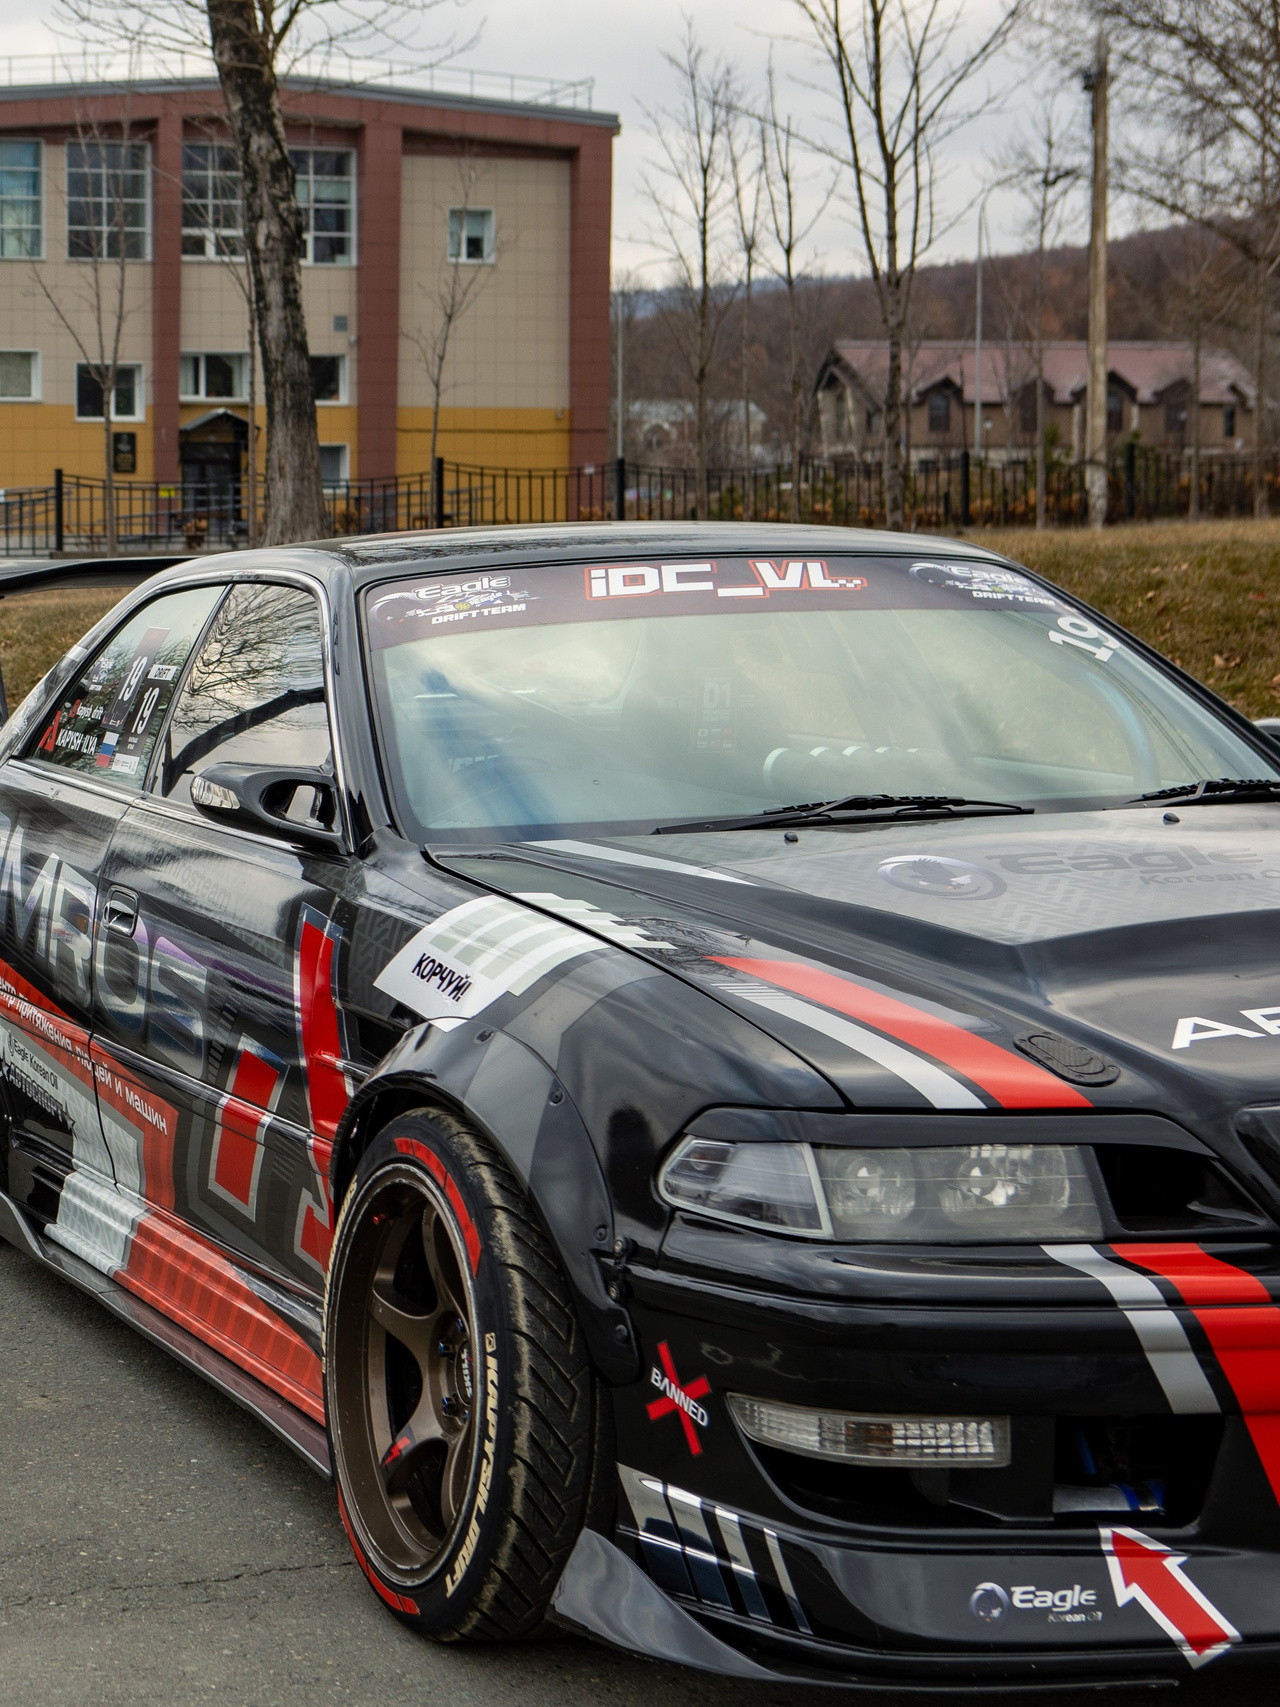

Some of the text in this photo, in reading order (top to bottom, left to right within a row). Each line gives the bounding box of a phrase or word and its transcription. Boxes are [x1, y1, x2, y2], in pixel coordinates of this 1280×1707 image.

[412, 576, 511, 599] Eagle
[972, 590, 1016, 601] DRIFT
[431, 603, 527, 625] DRIFT TEAM
[1048, 616, 1120, 662] 19
[118, 655, 148, 702] 19
[153, 667, 171, 679] DRIFT
[131, 687, 160, 735] 19
[985, 845, 1264, 875] Eagle
[1139, 870, 1256, 886] Korean
[412, 953, 472, 1002] КОРЧУЙ!
[13, 1038, 59, 1091] Eagle Korean Oil
[114, 1077, 123, 1098] и
[125, 1086, 168, 1136] машин
[650, 1365, 709, 1428] BANNED
[1010, 1583, 1098, 1613] Eagle
[1047, 1612, 1087, 1623] Korean
